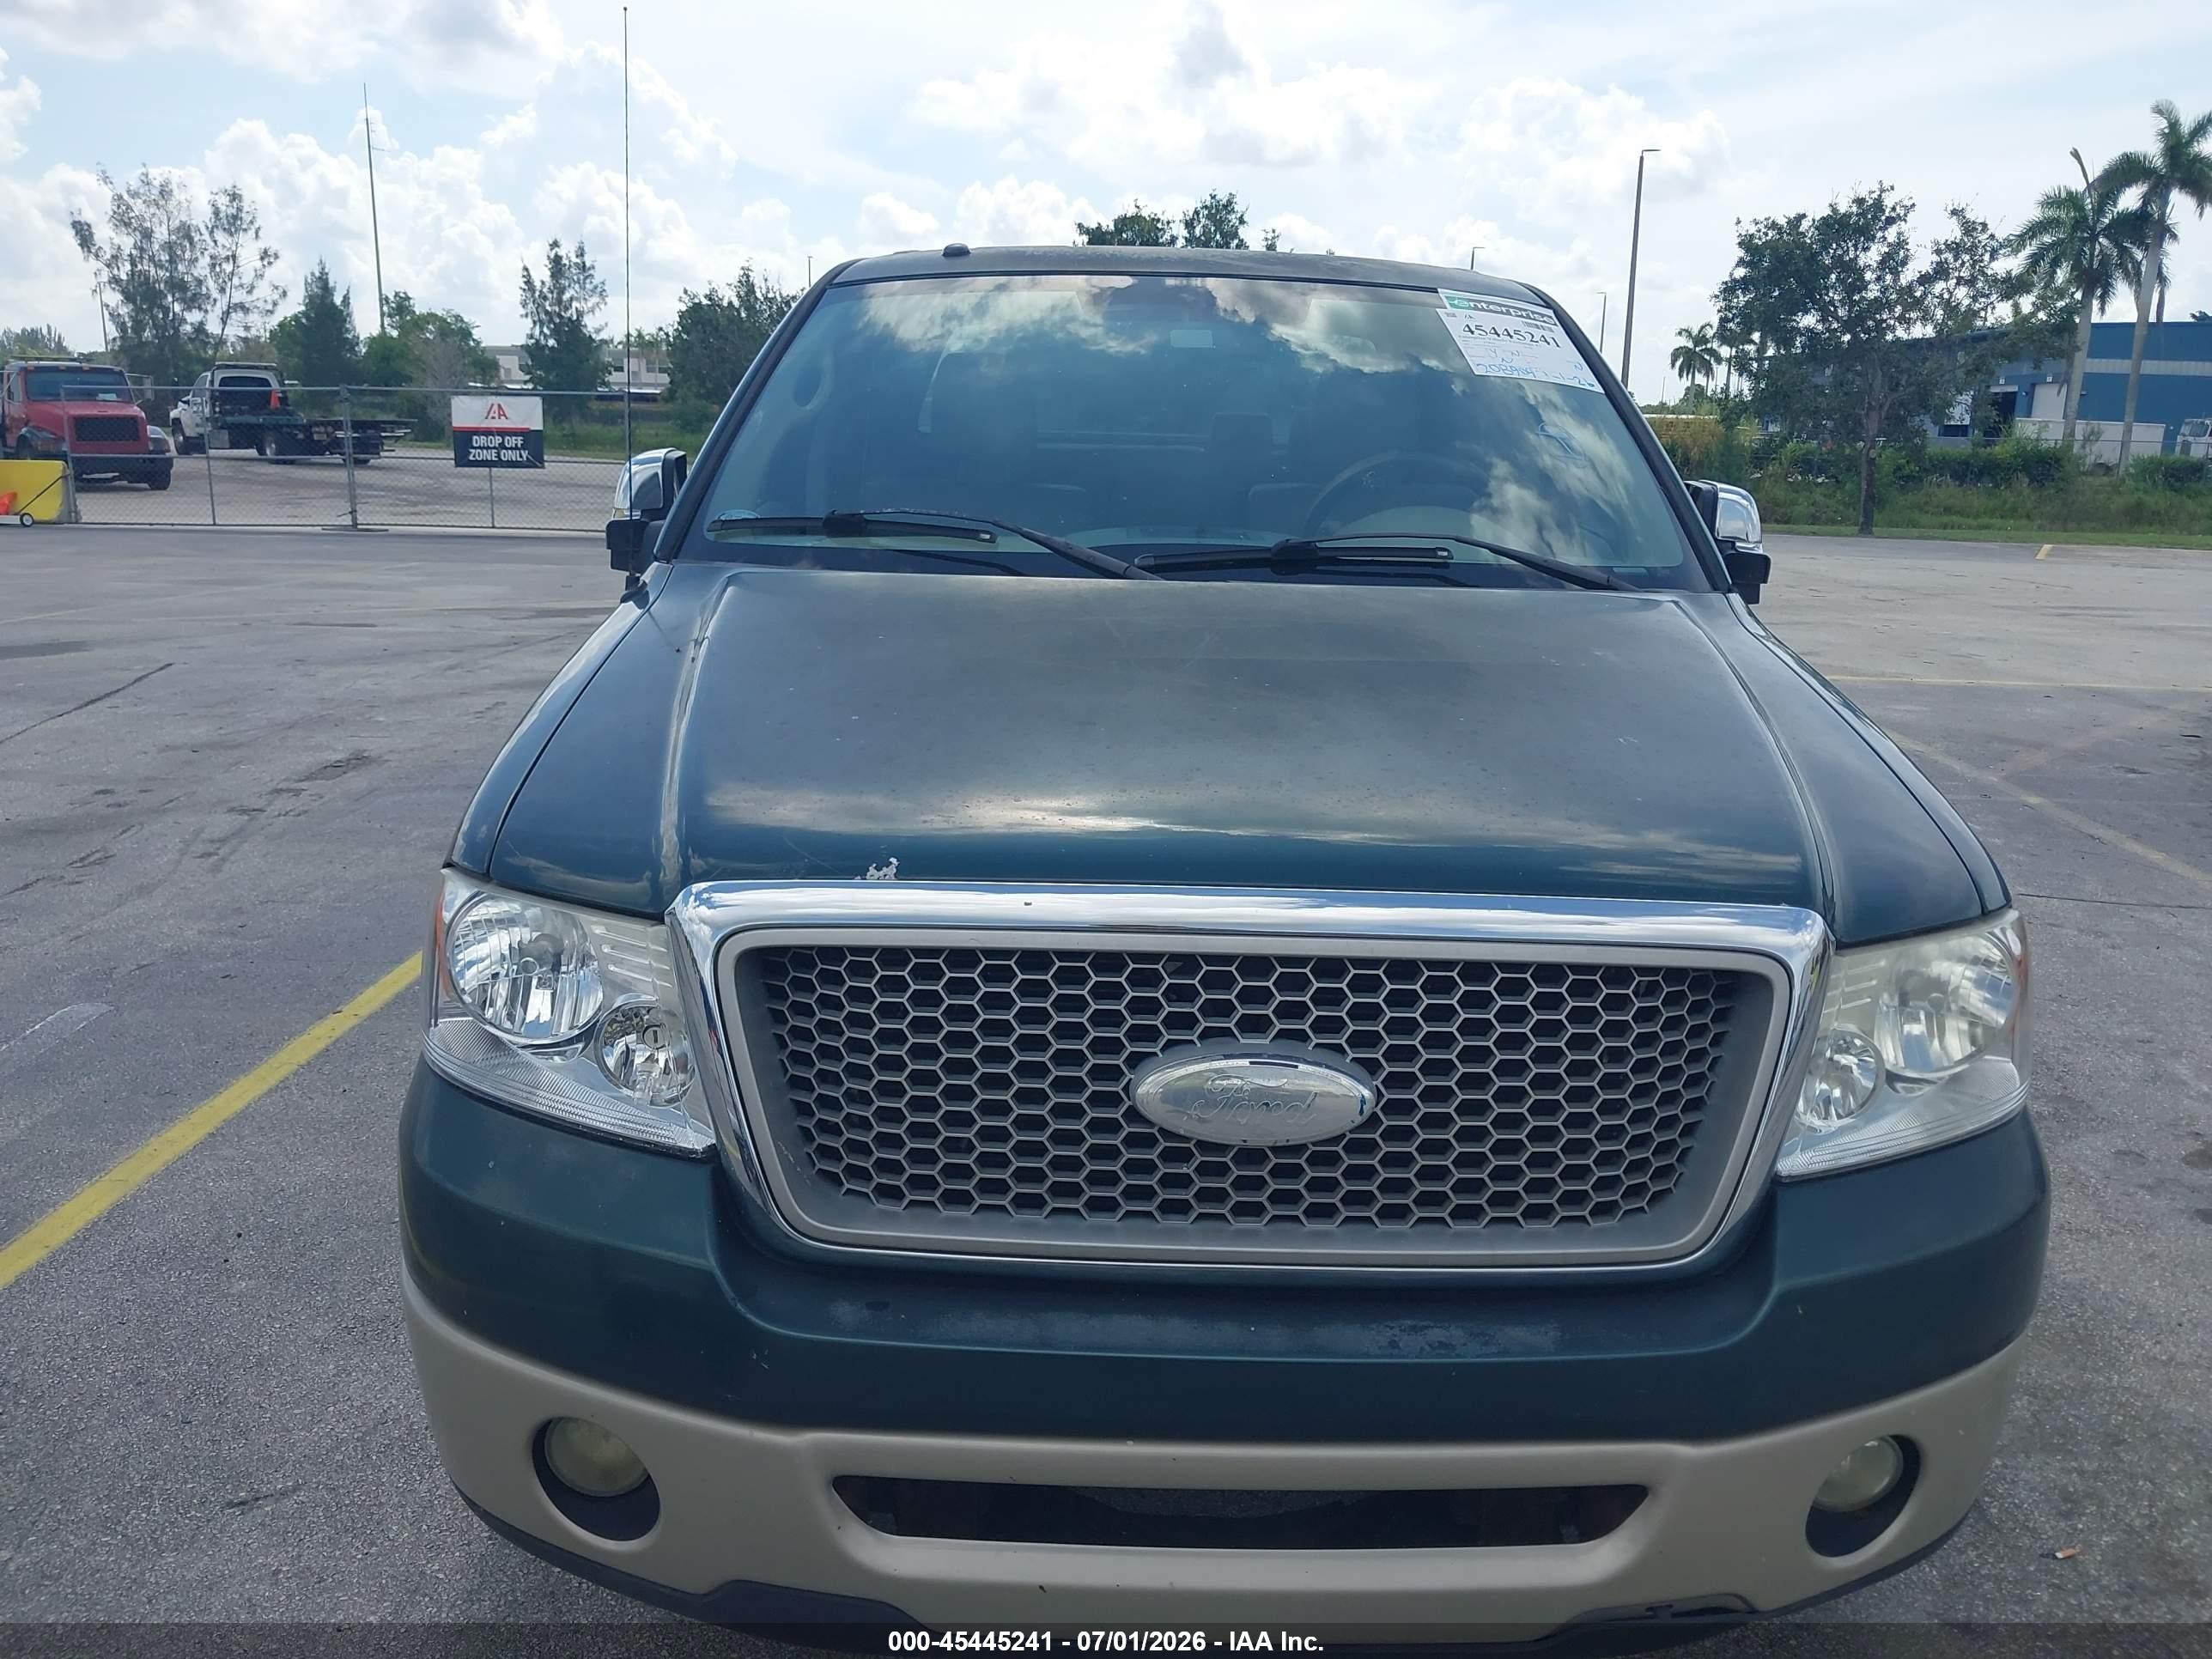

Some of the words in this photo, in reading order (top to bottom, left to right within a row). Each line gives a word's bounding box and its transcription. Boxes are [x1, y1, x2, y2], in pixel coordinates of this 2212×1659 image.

[1462, 324, 1561, 349] 45445241
[472, 435, 502, 447] DROP
[504, 436, 524, 447] OFF
[468, 448, 498, 461] ZONE
[500, 449, 528, 461] ONLY
[1183, 1073, 1318, 1124] Ford
